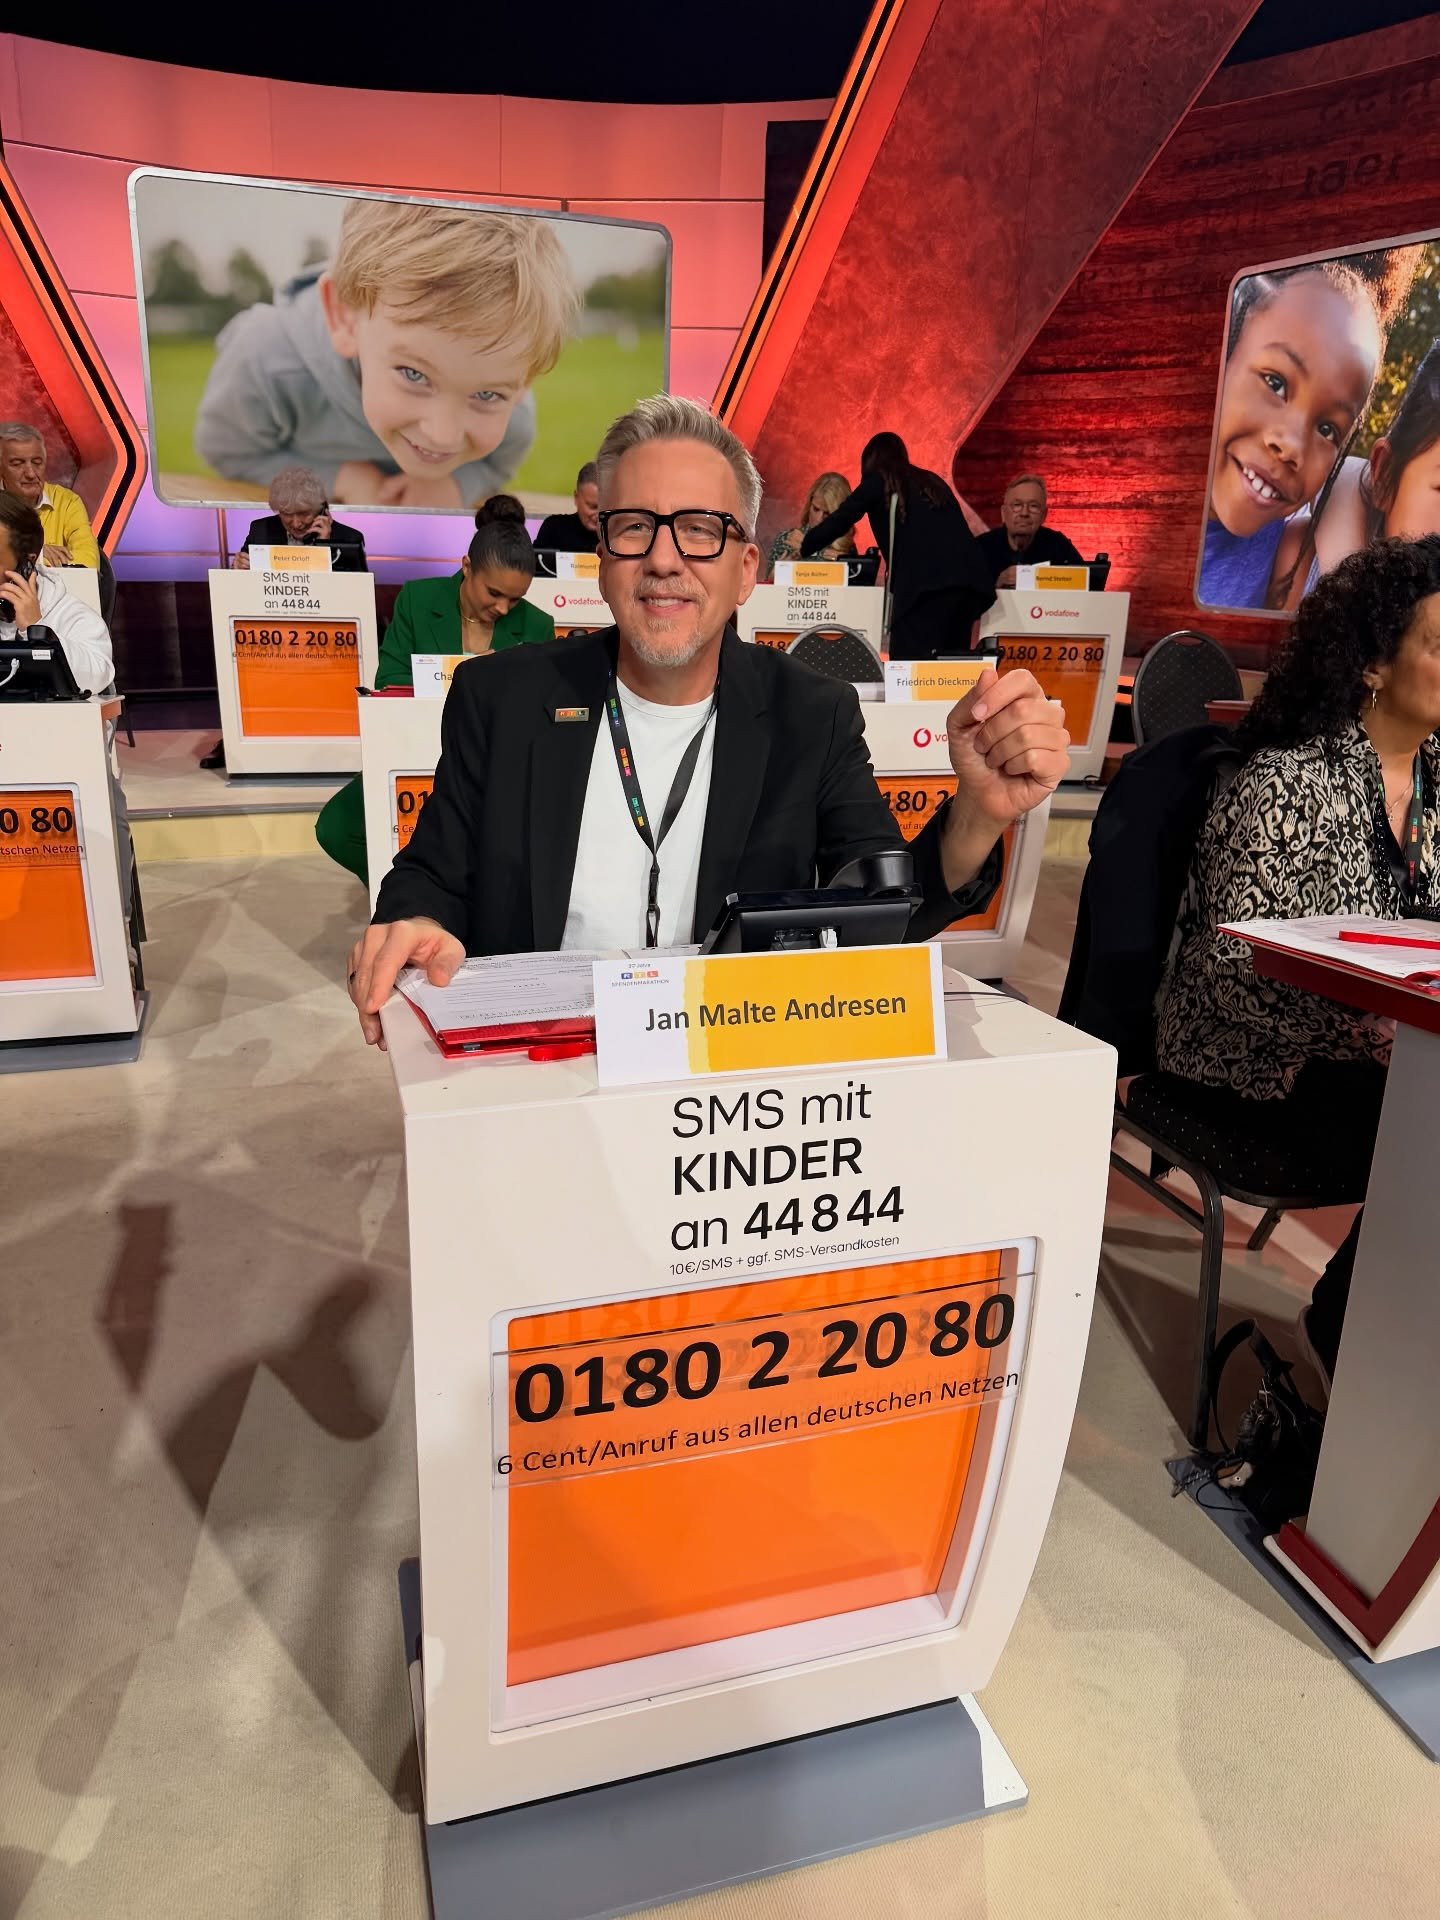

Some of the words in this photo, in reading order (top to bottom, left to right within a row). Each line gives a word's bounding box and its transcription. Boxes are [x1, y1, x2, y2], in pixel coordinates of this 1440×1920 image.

[263, 572, 290, 583] SMS
[292, 573, 310, 583] mit
[264, 585, 310, 596] KINDER
[787, 587, 811, 597] SMS
[813, 587, 829, 596] mit
[264, 600, 279, 609] an
[568, 598, 604, 606] vodafone
[787, 600, 828, 609] KINDER
[786, 613, 800, 621] an
[1044, 609, 1080, 618] vodafone
[235, 629, 283, 646] 0180
[288, 630, 299, 646] 2
[306, 631, 329, 647] 20
[334, 631, 357, 647] 80
[1042, 646, 1053, 660] 2
[1057, 647, 1079, 661] 20
[1083, 647, 1105, 661] 80
[434, 671, 453, 681] Cha
[897, 677, 935, 687] Friedrich
[934, 733, 948, 742] vo
[30, 806, 73, 833] 80
[393, 824, 399, 834] 6
[402, 824, 415, 833] Ce
[0, 845, 39, 856] tschen
[42, 843, 84, 854] Netzen
[621, 971, 659, 980] RTL
[645, 1008, 690, 1032] Jan
[699, 1000, 776, 1027] Malte
[784, 995, 906, 1022] Andresen
[672, 1088, 784, 1139] SMS
[801, 1080, 872, 1126] mit
[674, 1137, 863, 1196] KINDER
[671, 1216, 728, 1251] an
[669, 1256, 733, 1276] 10€/SMS
[735, 1256, 744, 1266] +
[746, 1251, 771, 1268] ggf.
[774, 1234, 900, 1262] SMS-Versandkosten
[514, 1340, 722, 1424] 0180
[748, 1330, 790, 1390] 2
[817, 1311, 908, 1379] 20
[928, 1293, 1015, 1358] 80
[497, 1454, 513, 1475] 6
[523, 1429, 679, 1472] Cent/Anruf
[685, 1426, 730, 1448] aus
[738, 1413, 799, 1439] allen
[806, 1389, 932, 1427] deutschen
[939, 1372, 1019, 1402] Netzen
